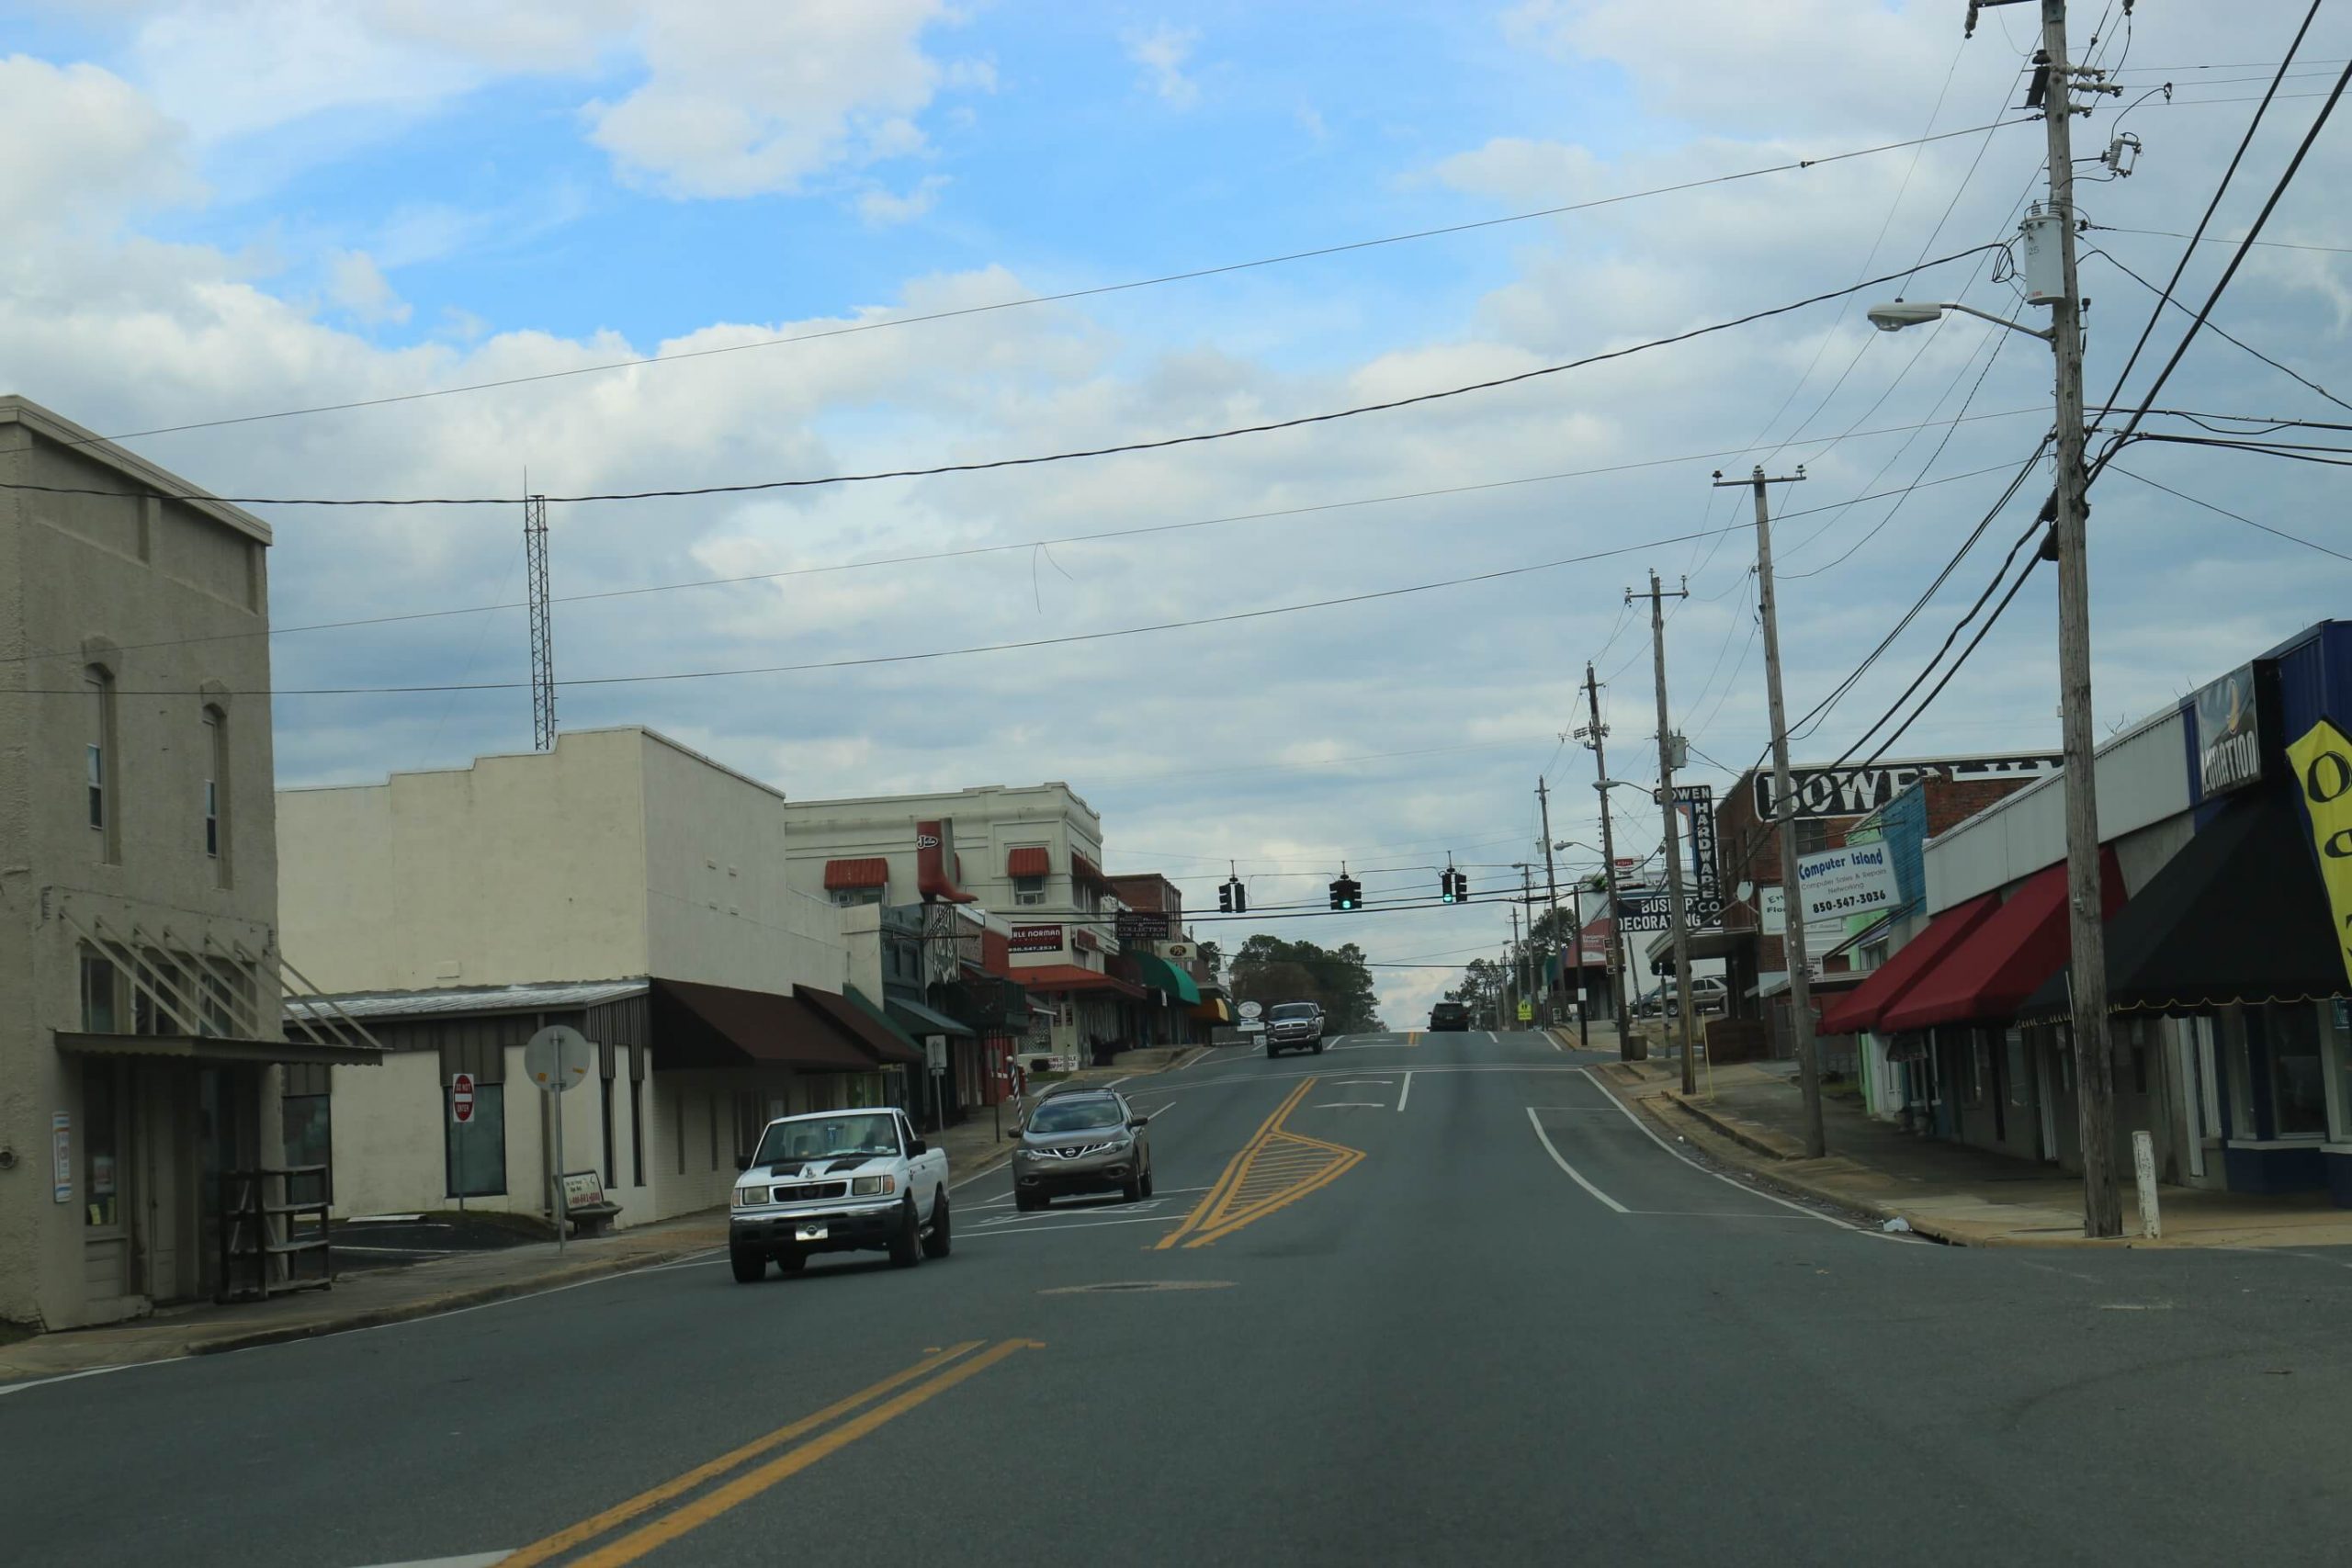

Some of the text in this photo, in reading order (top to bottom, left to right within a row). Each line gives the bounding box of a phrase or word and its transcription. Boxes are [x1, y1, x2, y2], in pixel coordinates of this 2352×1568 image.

[1762, 765, 1940, 816] BOWE
[1695, 803, 1715, 898] HARDWARE
[1798, 848, 1883, 880] Computer Island
[1801, 879, 1834, 890] Computer
[1836, 875, 1853, 884] Sales
[1863, 868, 1886, 879] Repairs
[1828, 882, 1864, 894] Networking
[1813, 890, 1886, 913] 850-547-3036
[1028, 929, 1060, 937] NORMAN
[1618, 914, 1701, 931] DECORATNG
